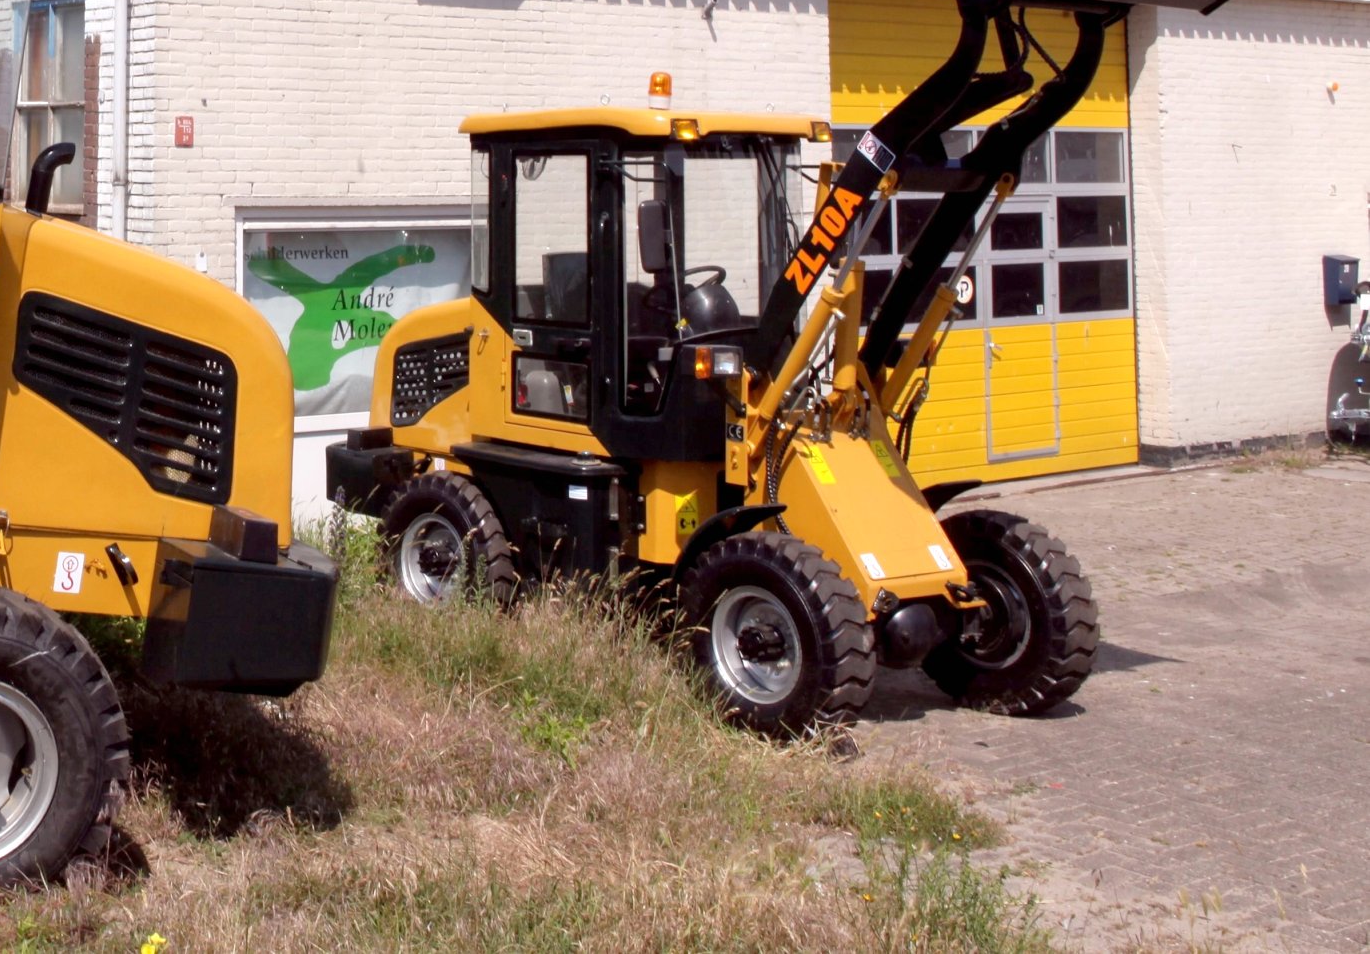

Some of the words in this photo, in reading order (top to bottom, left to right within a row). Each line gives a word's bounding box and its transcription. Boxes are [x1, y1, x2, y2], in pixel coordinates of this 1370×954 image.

[784, 186, 863, 295] ZL10A
[332, 286, 395, 311] André
[334, 316, 393, 342] Mole
